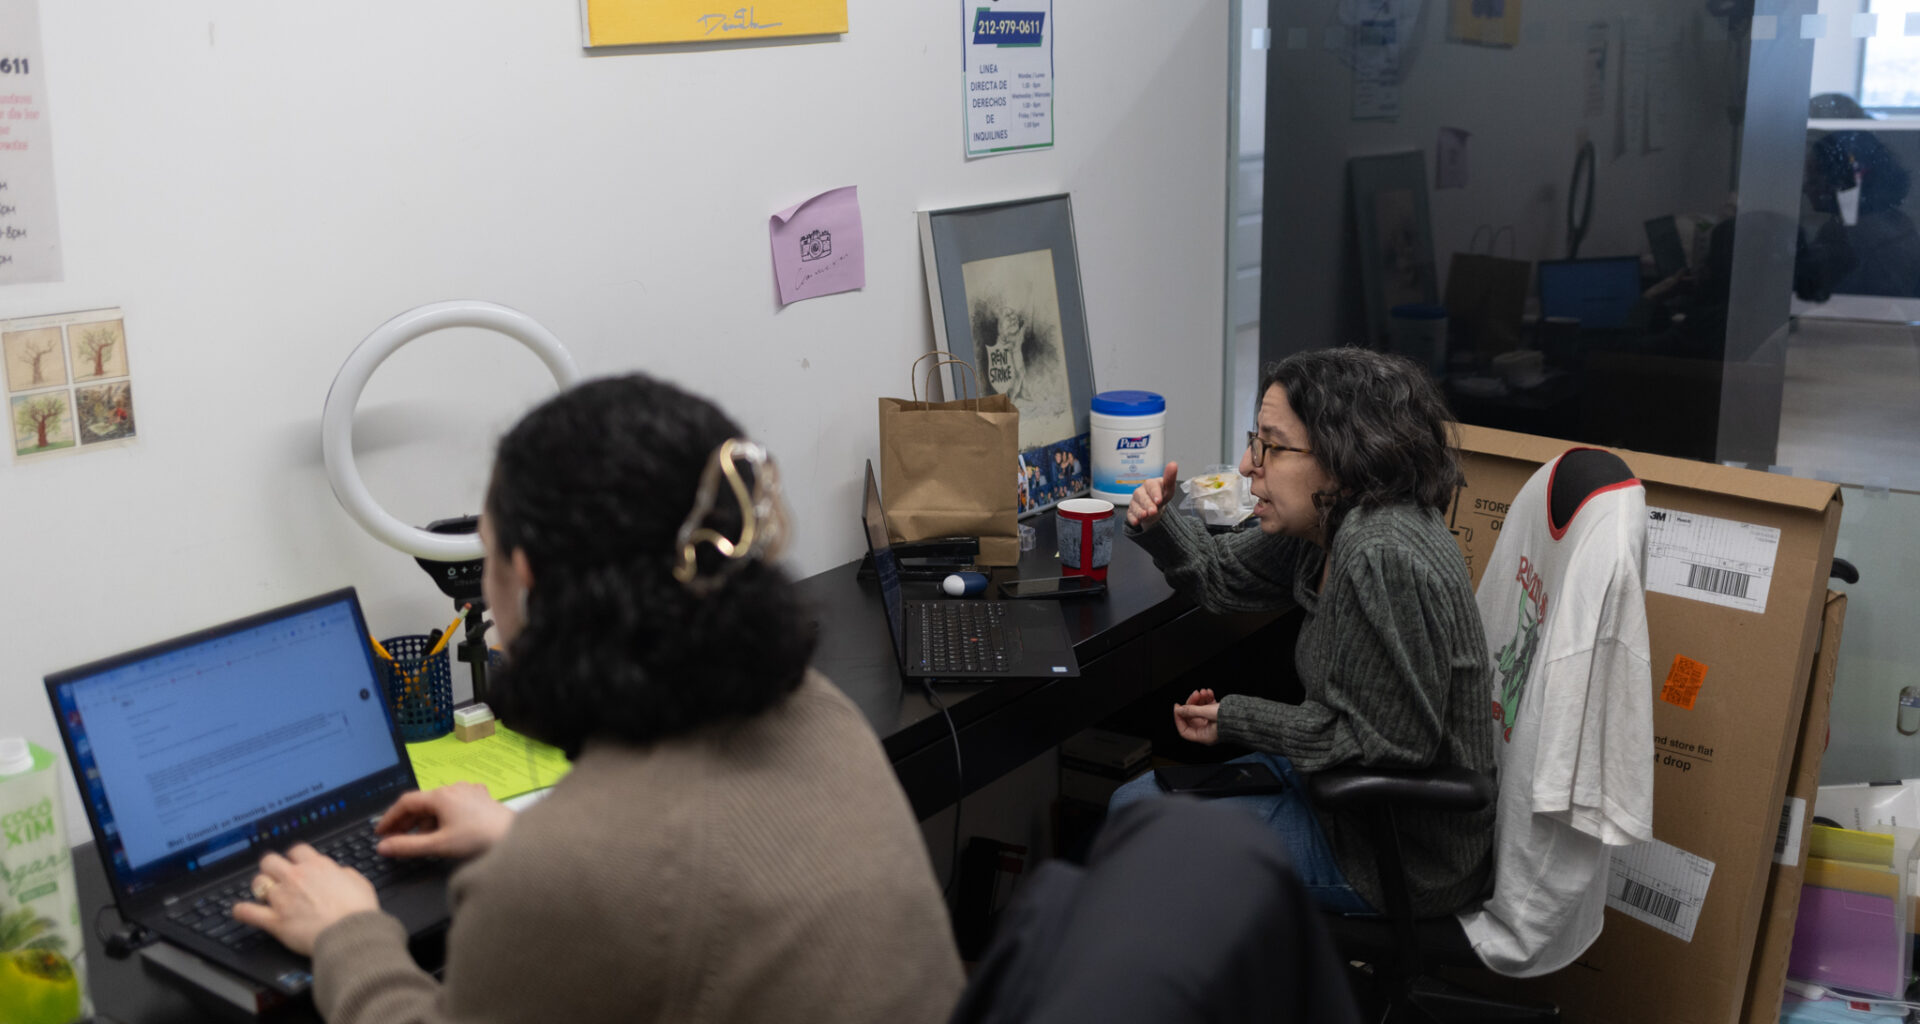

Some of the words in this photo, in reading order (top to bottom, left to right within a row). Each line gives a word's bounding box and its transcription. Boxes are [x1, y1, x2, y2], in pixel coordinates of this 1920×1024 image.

[978, 20, 1040, 35] 212-979-0611
[979, 64, 998, 74] LINEA
[970, 81, 998, 92] DIRECTA
[999, 80, 1008, 90] DE
[972, 97, 1007, 108] DERECHOS
[985, 114, 995, 124] DE
[973, 130, 1008, 142] INQUILINES
[990, 348, 1009, 366] RENT
[989, 366, 1012, 384] STRIKE
[1474, 498, 1511, 514] STORE
[1649, 511, 1666, 522] 3M
[1654, 736, 1668, 745] nd
[1669, 740, 1695, 752] store
[1697, 745, 1714, 757] flat
[1663, 755, 1692, 772] drop
[2, 797, 52, 828] COCO
[5, 816, 55, 850] XIM
